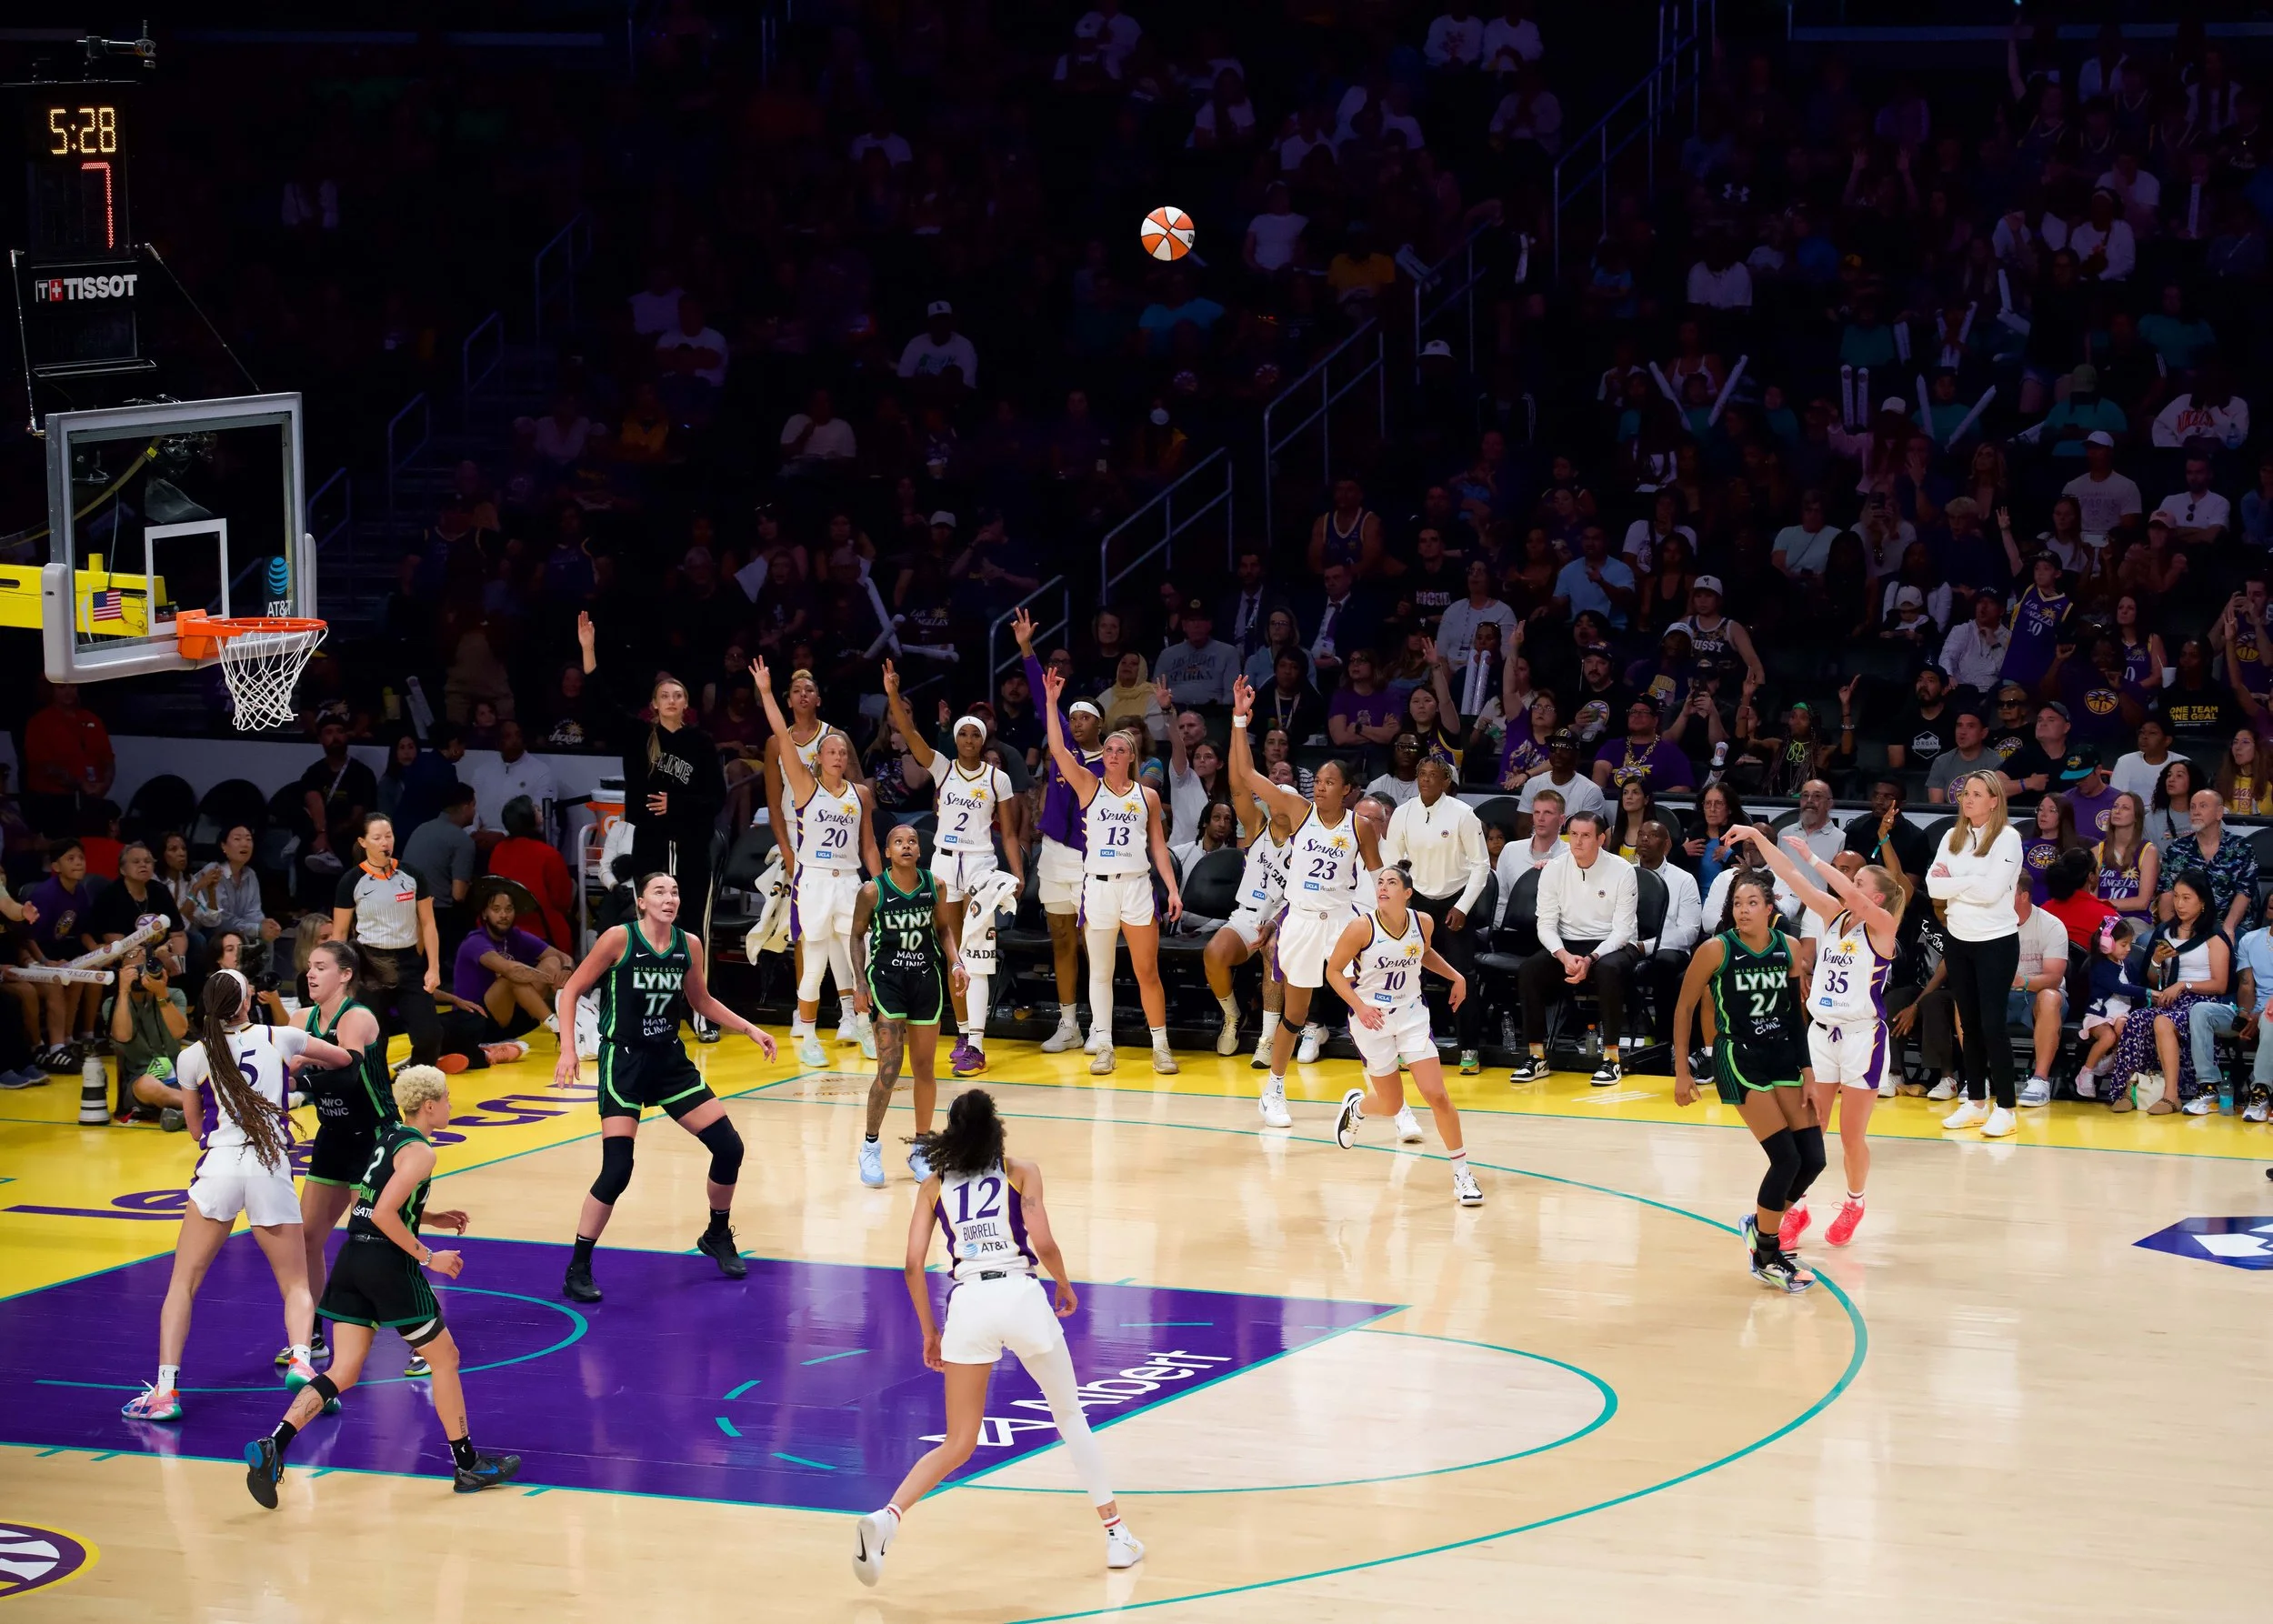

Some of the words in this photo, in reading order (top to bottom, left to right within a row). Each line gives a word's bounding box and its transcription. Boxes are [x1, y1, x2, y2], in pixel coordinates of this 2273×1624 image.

[50, 107, 116, 155] 5:28
[81, 162, 114, 249] 7
[63, 275, 137, 300] TISSOT
[267, 599, 293, 617] AT&T
[1694, 639, 1724, 653] USSY
[2191, 705, 2218, 713] TEAM
[944, 792, 984, 810] SPARKS
[815, 809, 856, 826] SPARKS
[954, 812, 969, 831] 2
[1097, 808, 1138, 824] SPARKS
[821, 827, 848, 847] 20
[1106, 827, 1130, 846] 13
[1303, 838, 1346, 858] SPARKS
[1308, 857, 1337, 880] 23
[2099, 867, 2115, 877] LOS
[1305, 882, 1319, 890] UCLA
[2100, 878, 2139, 888] ANGELES
[1254, 891, 1266, 899] UCLA
[884, 906, 933, 916] MINNESOTA
[884, 910, 933, 929] LYNX
[899, 930, 923, 951] 10
[896, 950, 925, 960] MAYO
[1374, 957, 1418, 969] SPARKS
[633, 972, 683, 990] LYNX
[1382, 971, 1406, 990] 10
[1735, 970, 1787, 991] LYNX
[1825, 970, 1848, 993] 35
[645, 993, 673, 1016] 77
[238, 1049, 258, 1087] 5
[363, 1146, 386, 1184] 2
[953, 1177, 1001, 1224] 12
[963, 1222, 998, 1241] BURRELL
[981, 1241, 1008, 1253] AT&T
